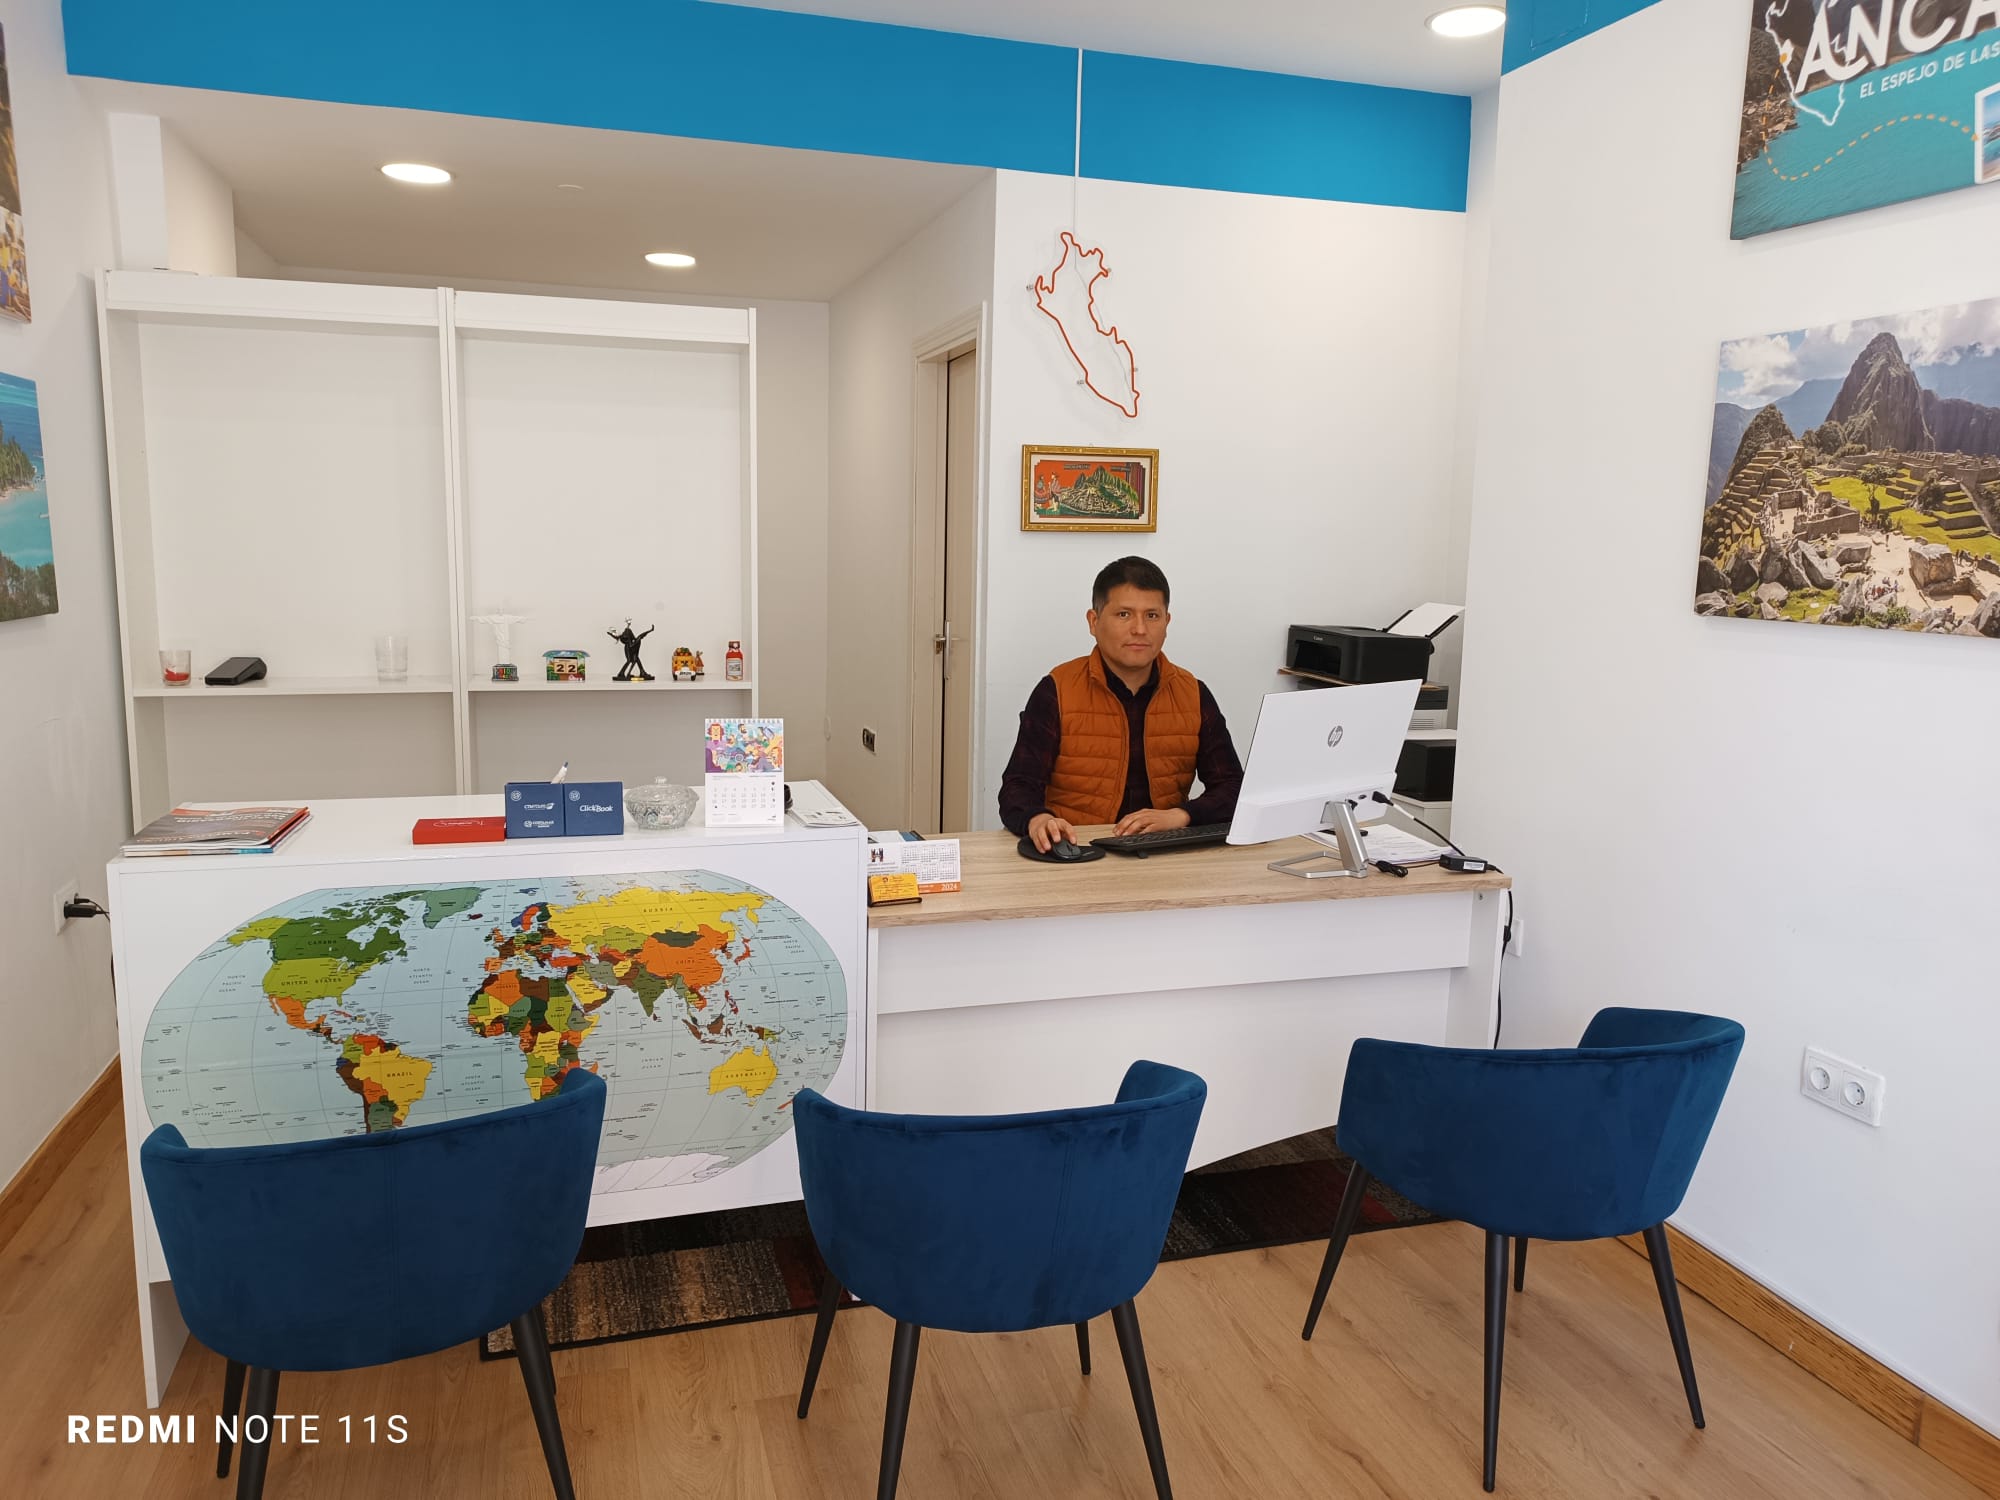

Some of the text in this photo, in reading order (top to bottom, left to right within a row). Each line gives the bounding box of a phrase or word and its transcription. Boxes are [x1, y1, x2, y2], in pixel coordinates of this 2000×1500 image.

[1859, 39, 2000, 99] EL ESPEJO DE LAS
[579, 804, 614, 813] ClickBook
